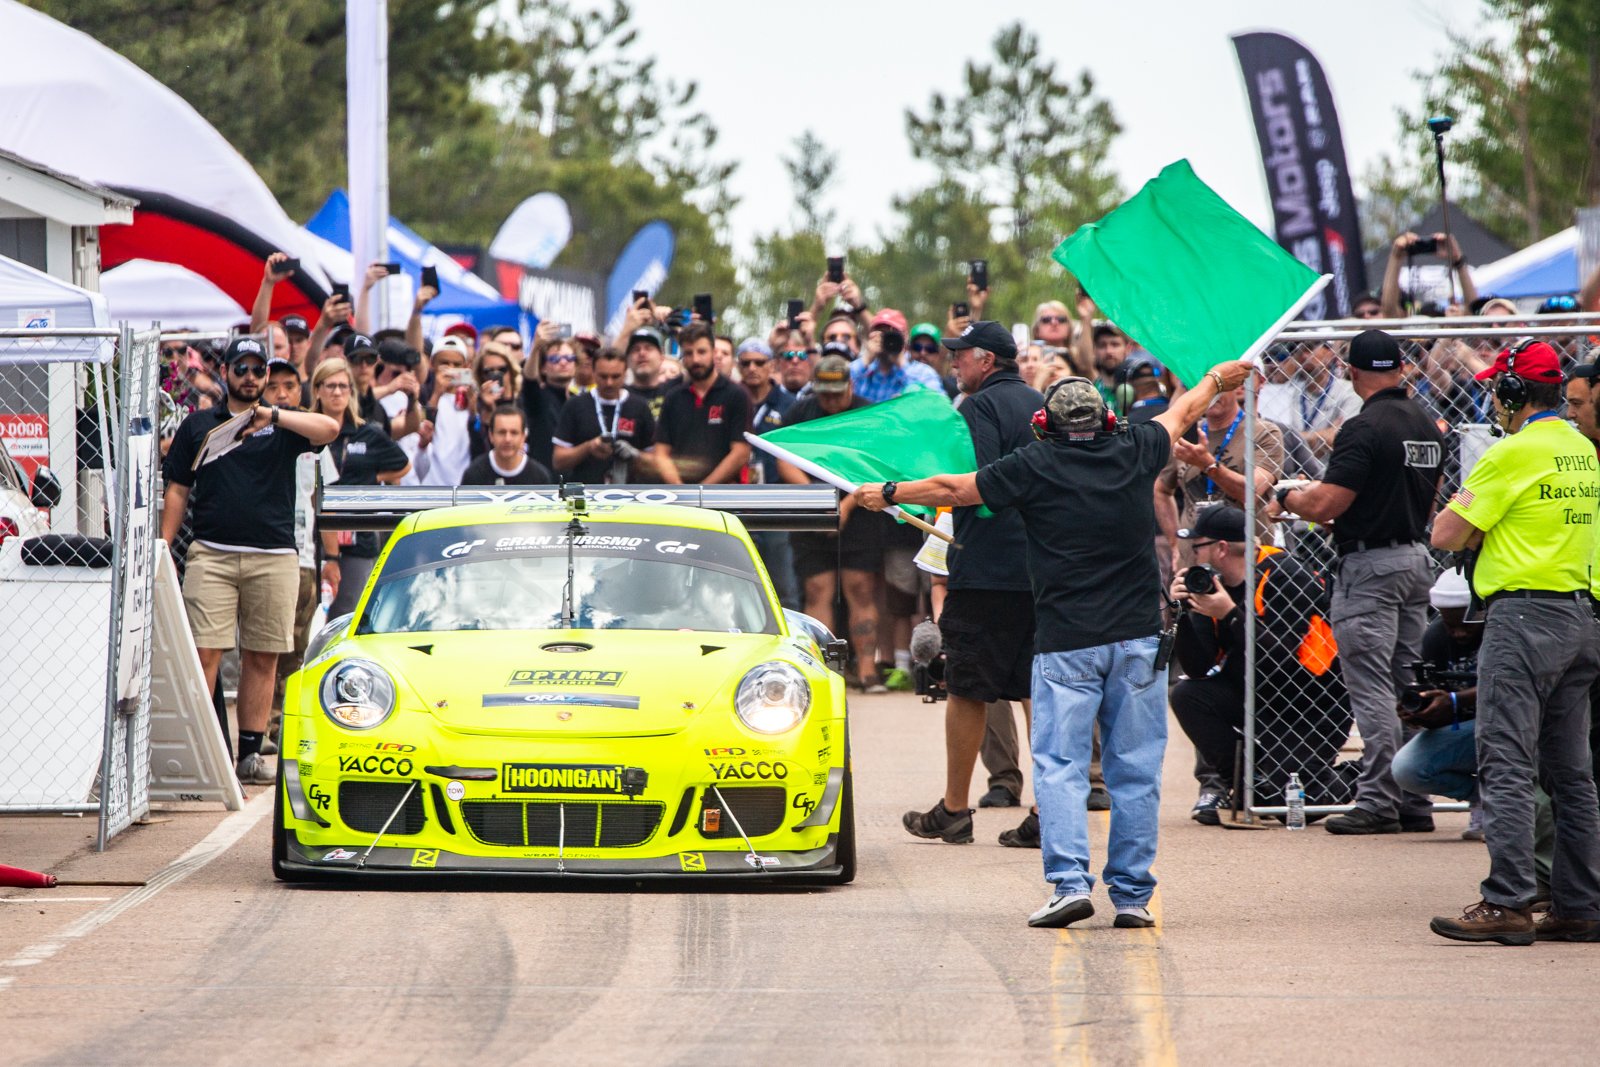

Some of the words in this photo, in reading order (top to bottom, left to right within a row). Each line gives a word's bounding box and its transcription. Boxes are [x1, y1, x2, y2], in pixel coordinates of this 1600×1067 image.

[1257, 68, 1316, 238] Motors
[8, 422, 43, 437] DOOR
[1554, 455, 1596, 472] PPIHC
[1539, 483, 1577, 500] Race
[1579, 481, 1600, 498] Safe
[1563, 508, 1592, 525] Team
[495, 536, 552, 547] GRAN
[515, 670, 617, 681] OPTIMA
[375, 742, 417, 753] IPD
[703, 747, 746, 756] IPD
[338, 755, 414, 777] YACCO
[708, 761, 788, 780] YACCO
